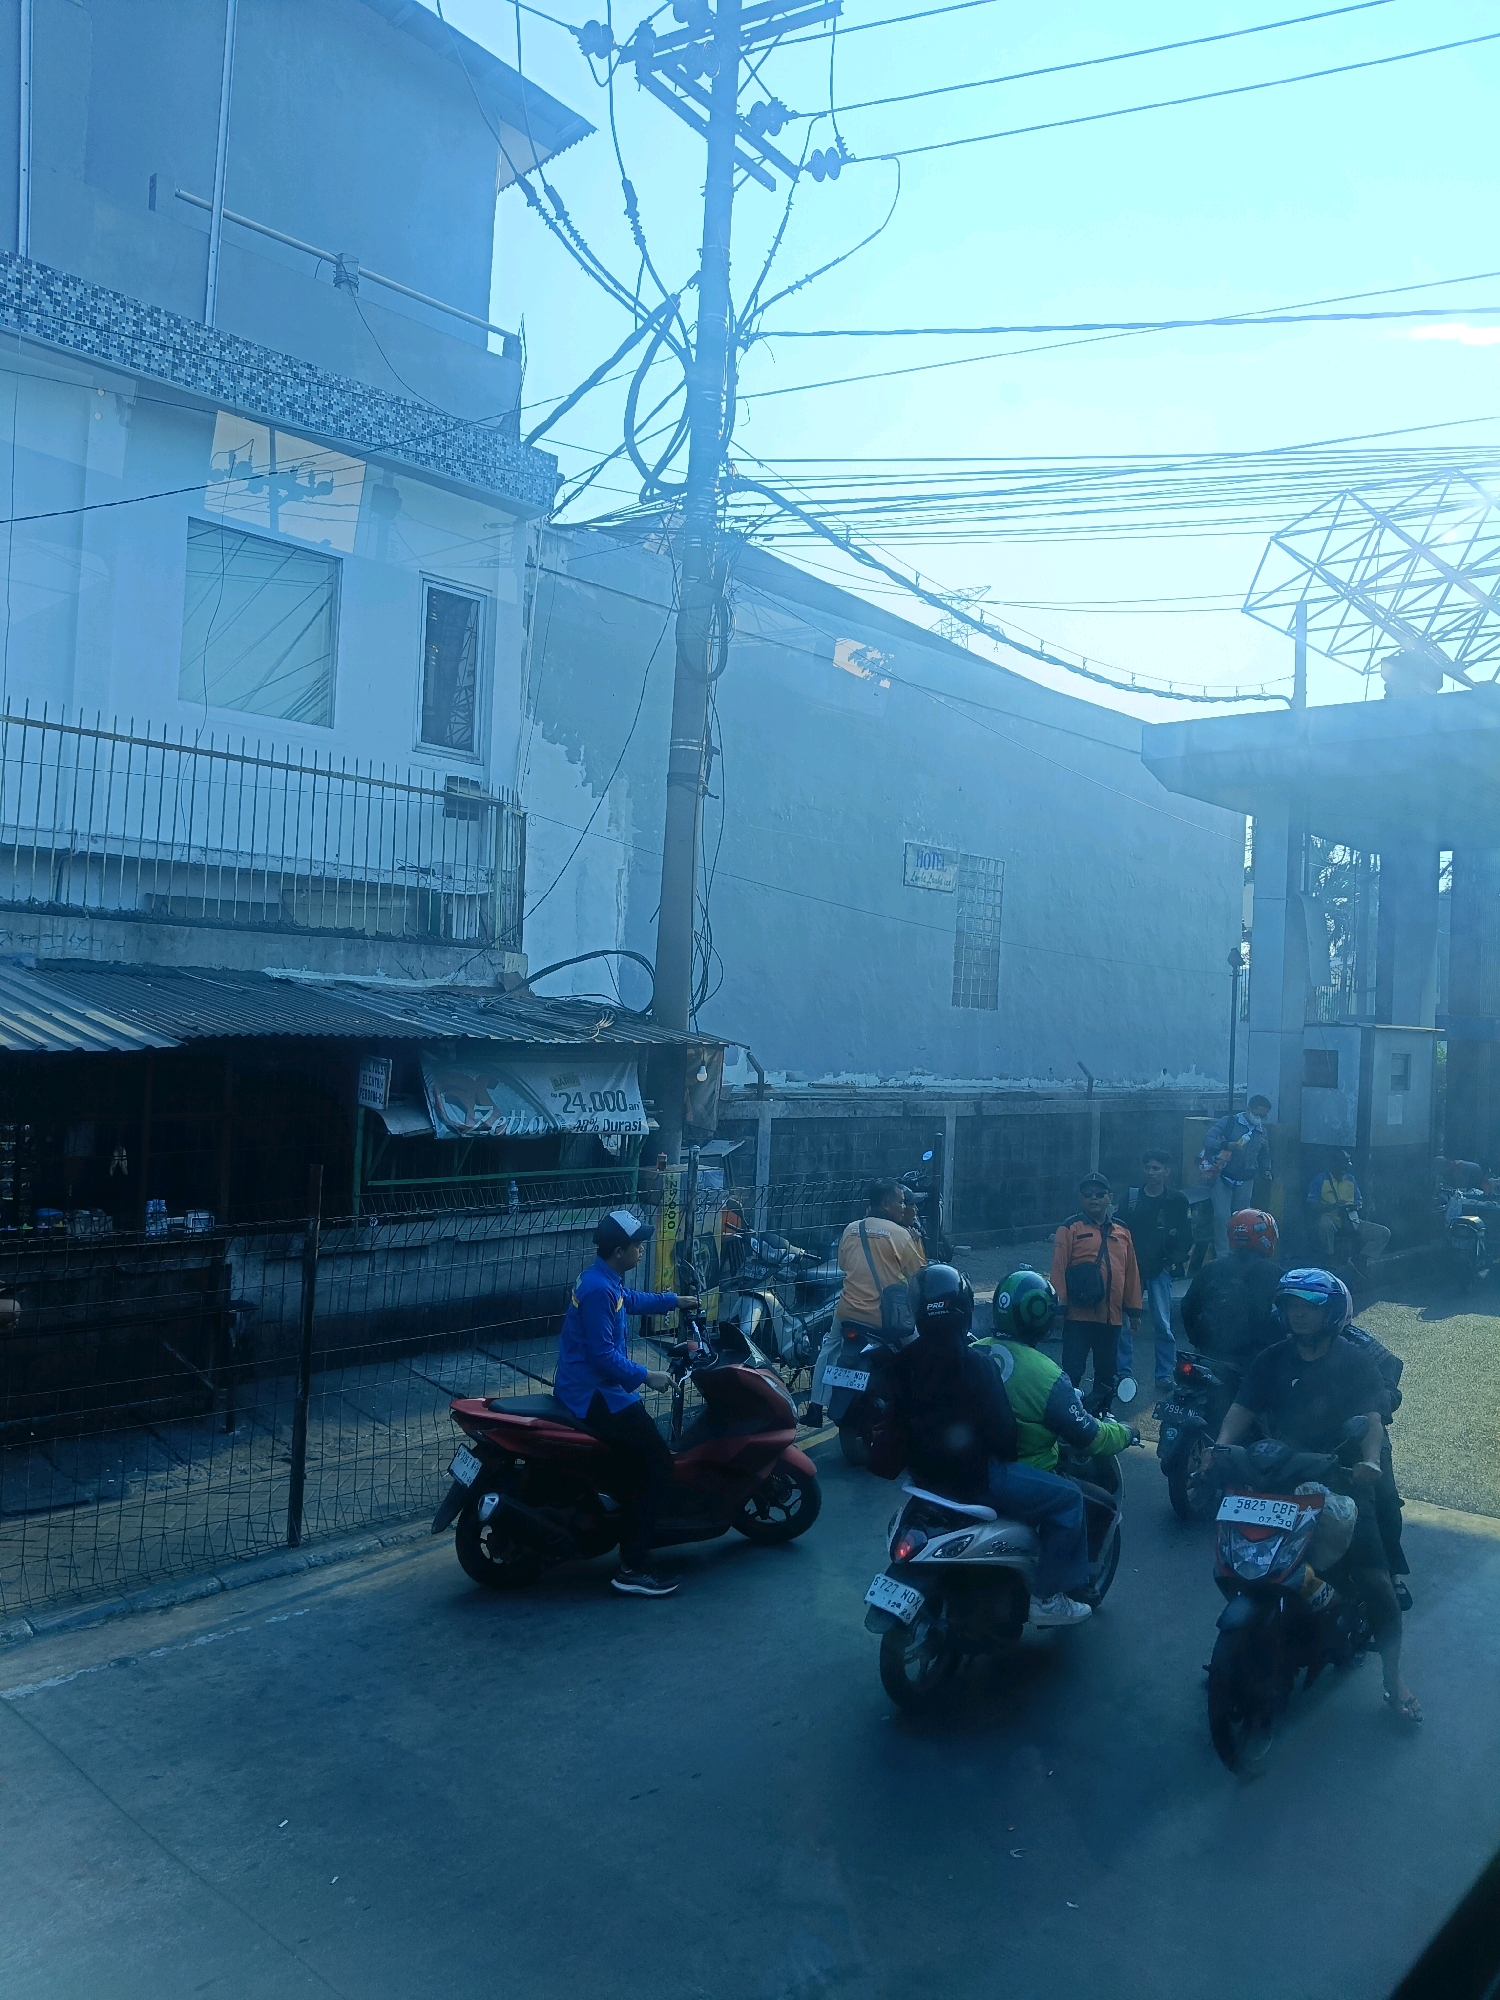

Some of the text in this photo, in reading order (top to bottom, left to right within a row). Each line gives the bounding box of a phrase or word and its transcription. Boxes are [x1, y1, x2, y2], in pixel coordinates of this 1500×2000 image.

[916, 849, 947, 872] HOTEL
[462, 1104, 549, 1138] Zetta
[603, 1118, 642, 1133] Durasi
[926, 1300, 945, 1310] PRO
[1236, 1498, 1267, 1512] 5825
[1272, 1502, 1297, 1516] CBF
